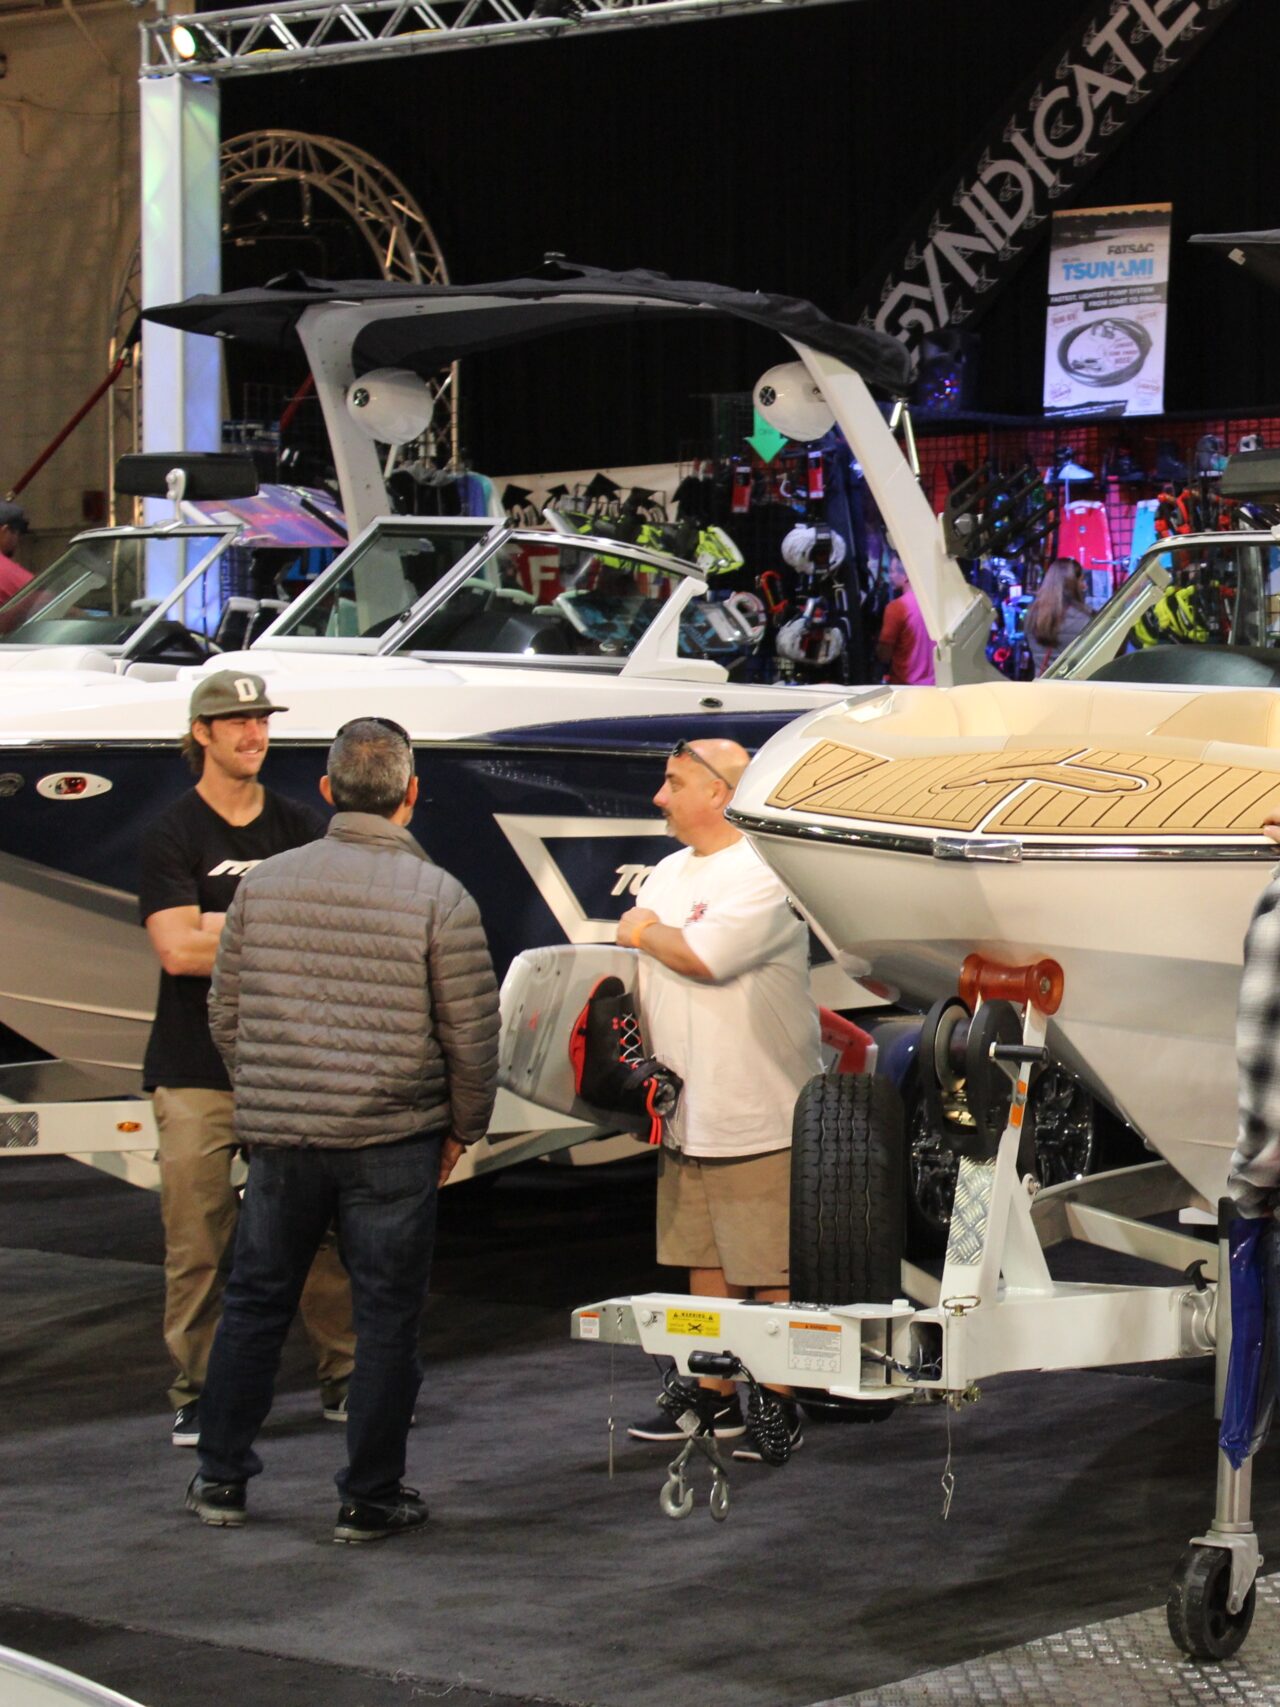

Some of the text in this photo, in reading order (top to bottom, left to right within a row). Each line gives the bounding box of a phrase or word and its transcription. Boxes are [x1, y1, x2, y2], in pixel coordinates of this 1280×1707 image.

[1107, 243, 1155, 255] FATSAC
[1062, 258, 1154, 281] TSUNAMI
[610, 863, 656, 896] TO
